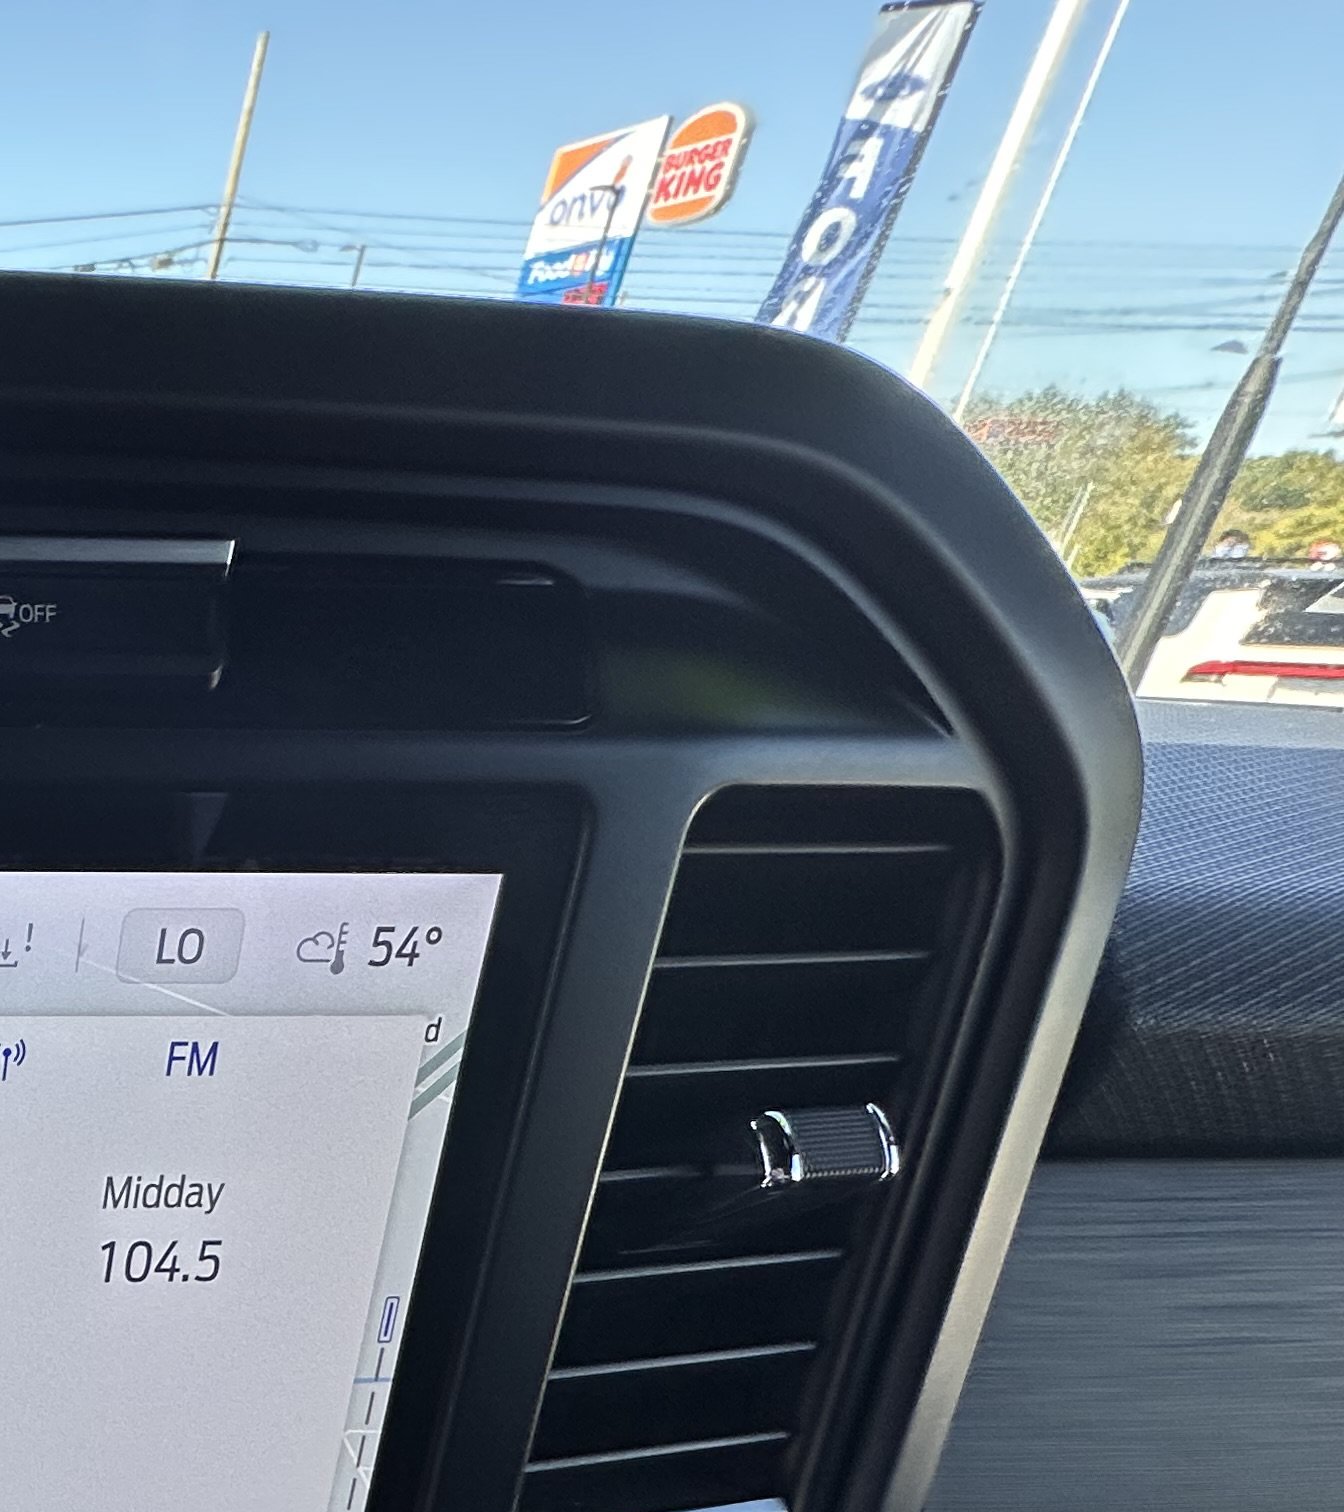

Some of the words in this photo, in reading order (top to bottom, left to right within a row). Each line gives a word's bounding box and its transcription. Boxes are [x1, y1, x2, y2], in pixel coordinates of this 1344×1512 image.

[662, 138, 733, 173] BURGER
[654, 162, 725, 204] KING
[18, 603, 57, 623] OFF
[155, 927, 204, 965] LO
[367, 926, 443, 967] 54°
[165, 1041, 219, 1077] FM
[101, 1174, 225, 1214] Midday
[100, 1240, 223, 1284] 104.5
